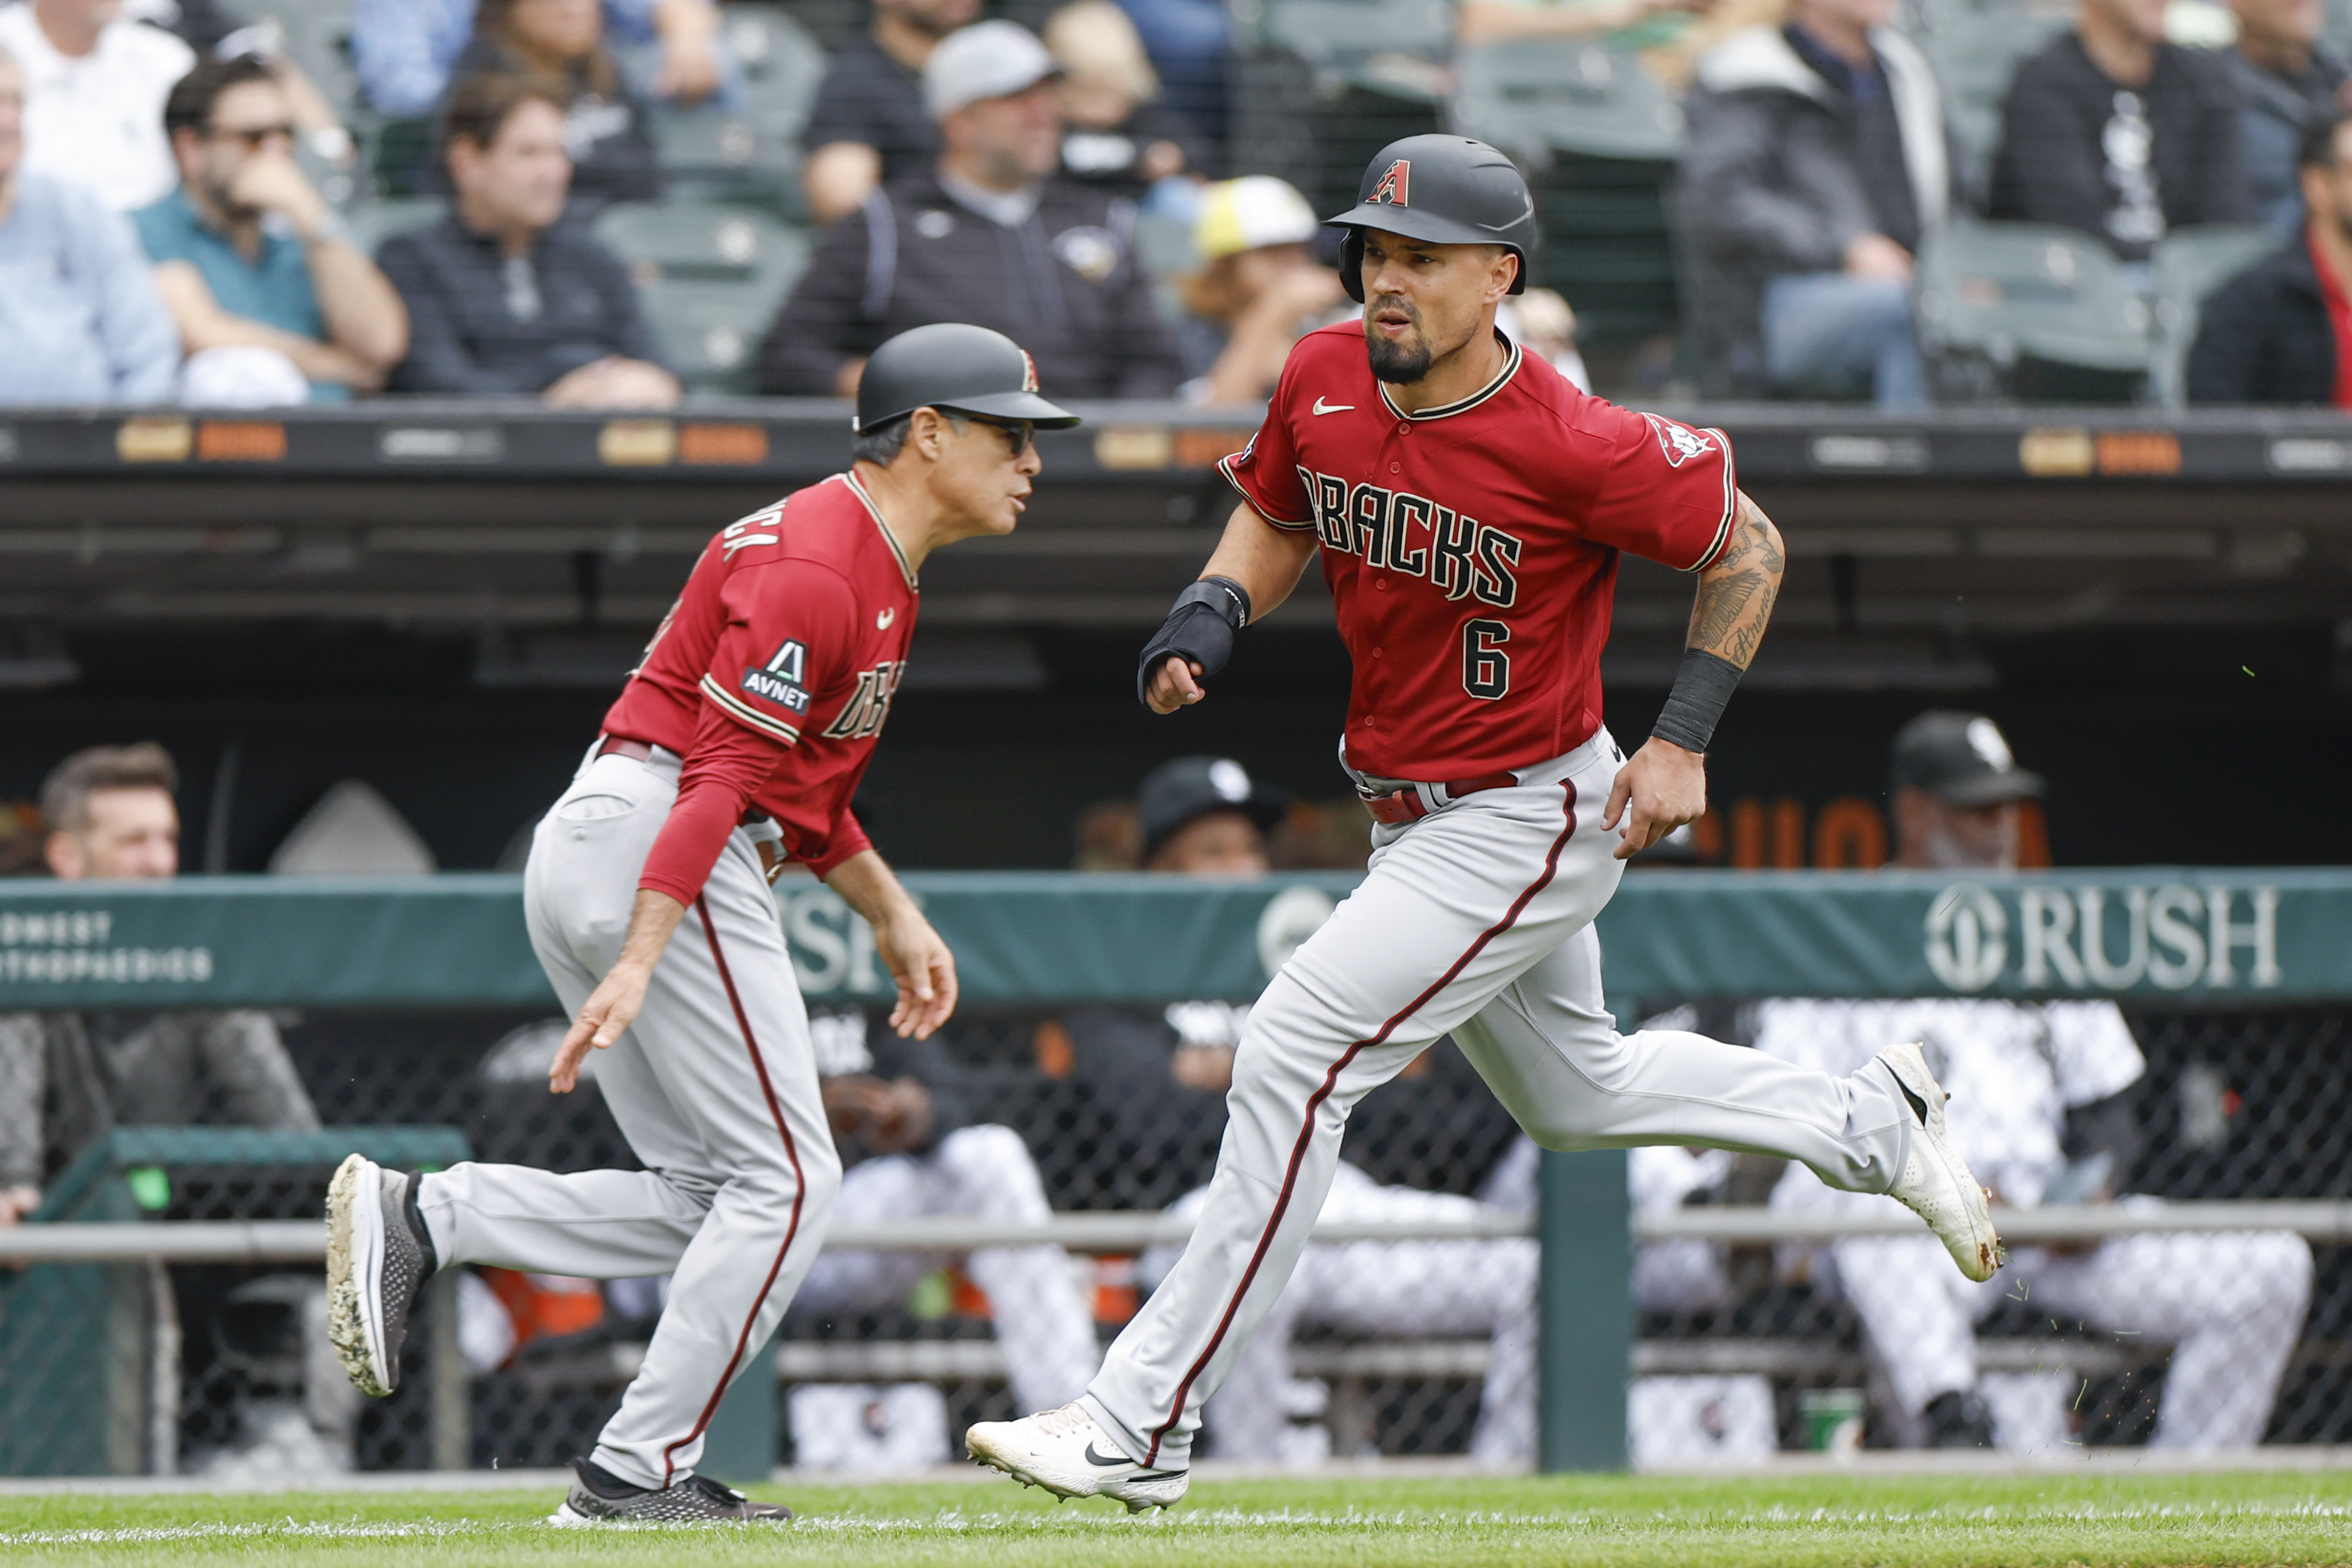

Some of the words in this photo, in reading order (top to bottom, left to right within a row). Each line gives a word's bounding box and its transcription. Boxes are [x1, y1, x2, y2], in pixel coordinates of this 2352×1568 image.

[1365, 159, 1411, 208] A
[1462, 618, 1511, 701] 6
[744, 673, 810, 710] AVNET
[2020, 885, 2281, 990] RUSH
[0, 947, 213, 983] THOPAEDICS
